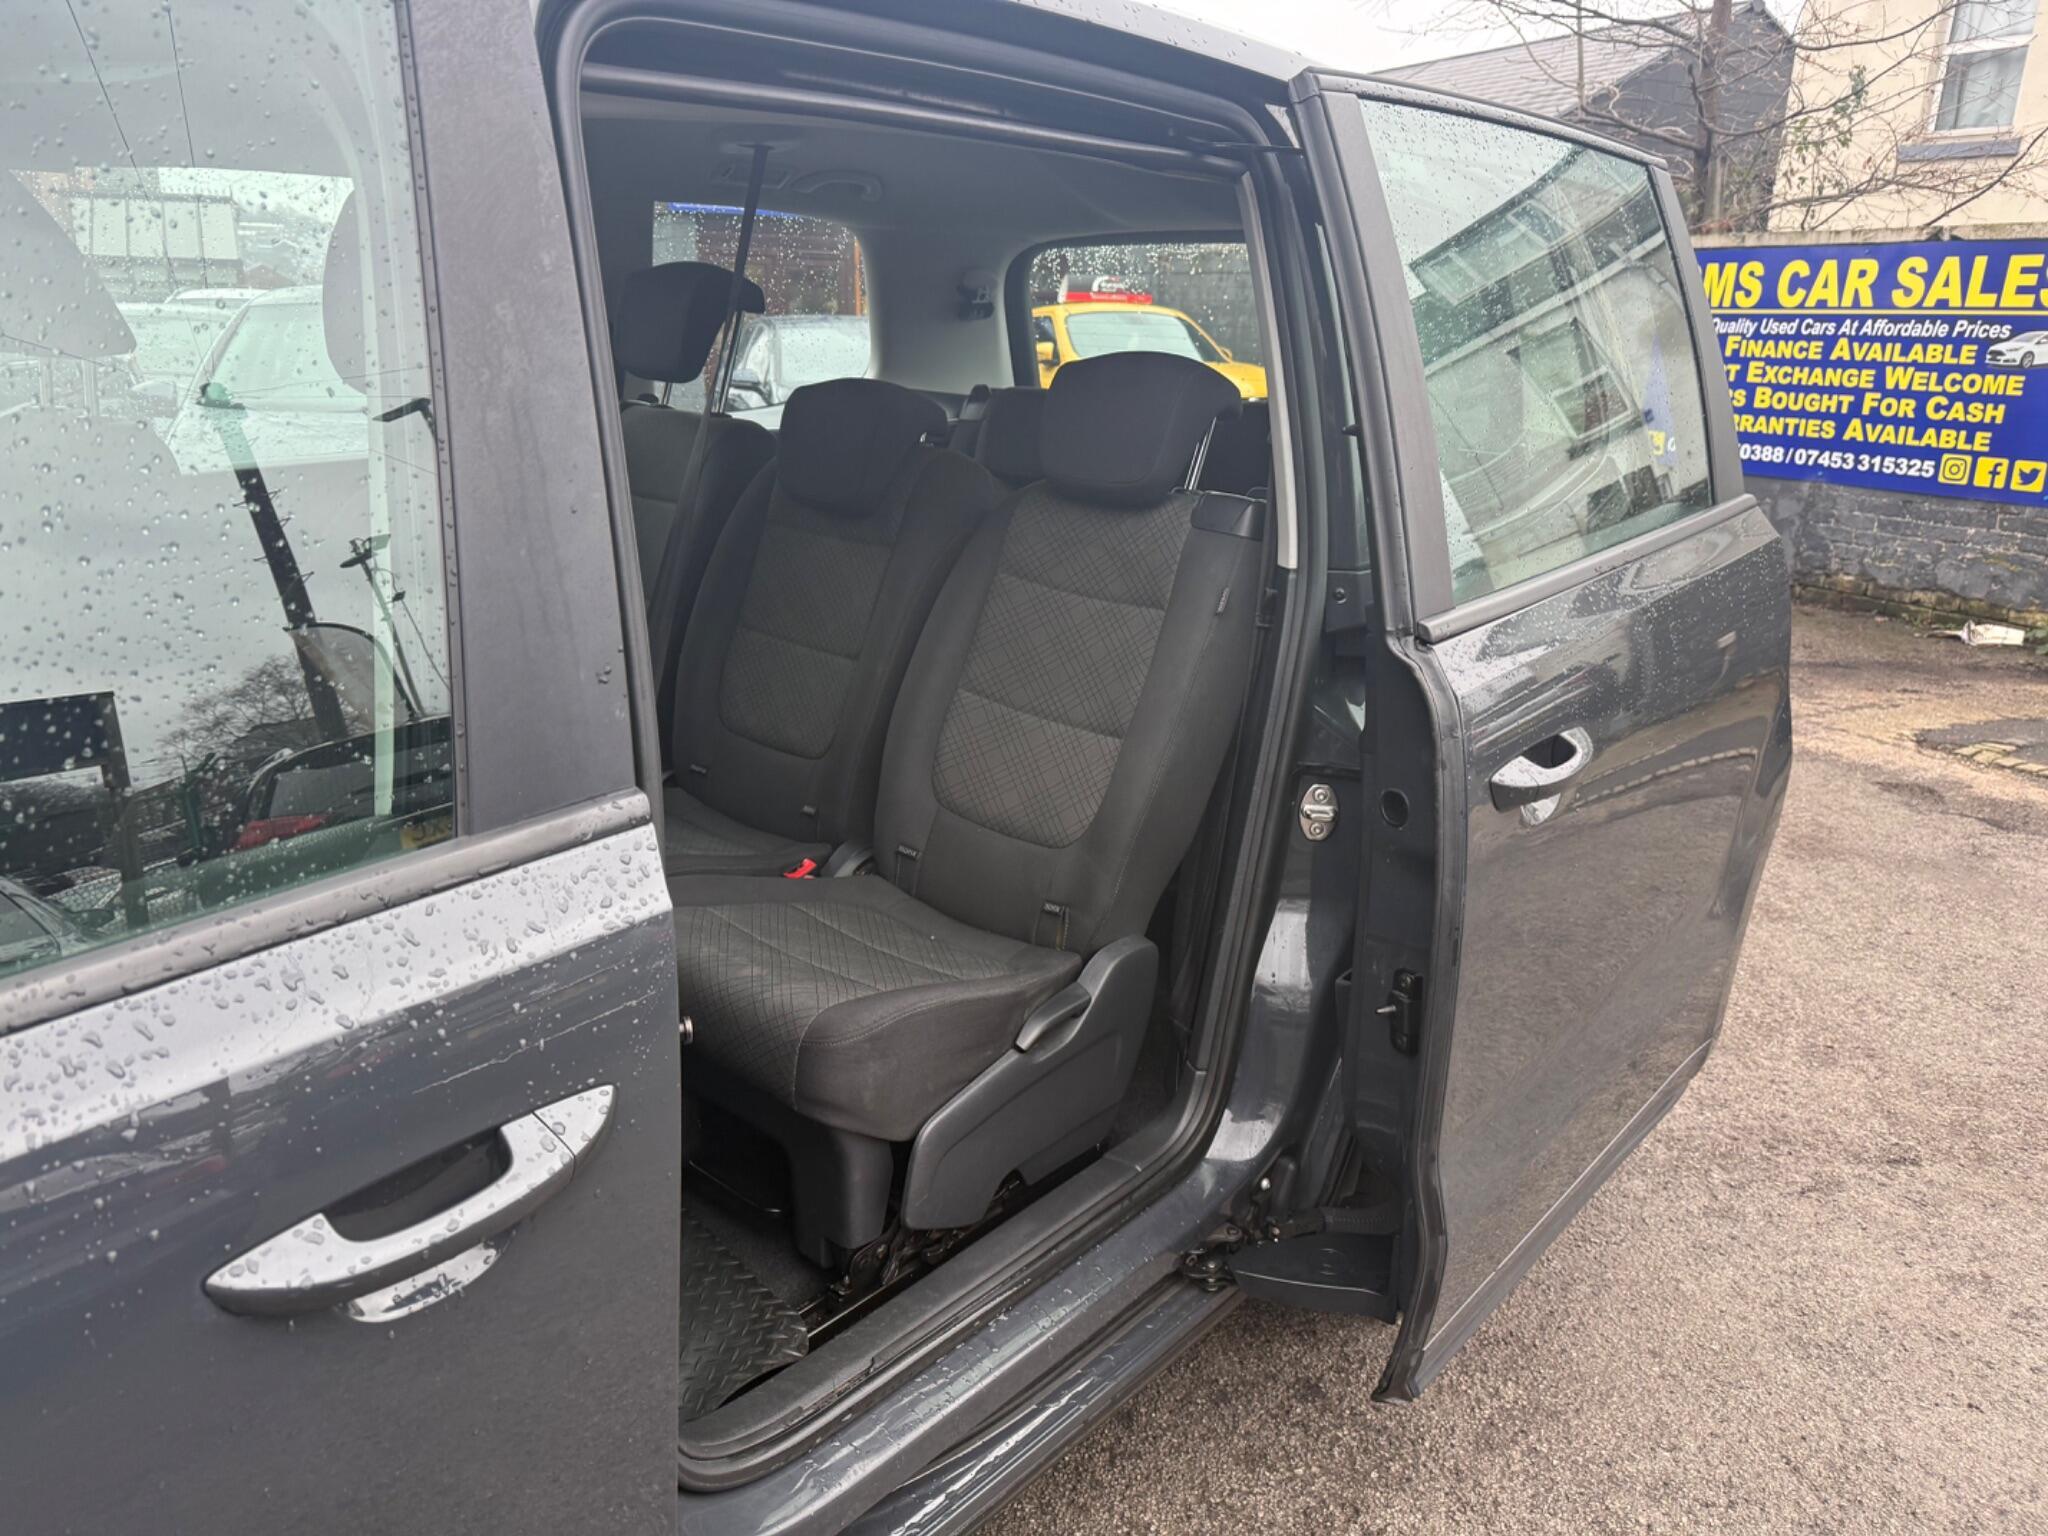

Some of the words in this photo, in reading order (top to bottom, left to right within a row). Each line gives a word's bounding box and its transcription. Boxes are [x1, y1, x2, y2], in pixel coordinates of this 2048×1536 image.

[1776, 257, 1879, 308] CAR
[1891, 253, 2048, 308] SALE
[1760, 318, 1800, 335] Used
[1801, 318, 1836, 336] Cars
[1837, 319, 1860, 336] At
[1859, 319, 1949, 338] Affordable
[1952, 320, 2012, 339] Prices
[1724, 335, 1824, 359] FINANCE
[1830, 337, 1978, 365] AVAILABLE
[1746, 361, 1876, 388] EXCHANGE
[1885, 365, 2026, 396] WELCOME
[1754, 386, 1855, 414] BOUGHT
[1861, 391, 1916, 418] FOR
[1926, 395, 2006, 424] CASH
[1842, 418, 1992, 452] AVAILABLE
[1857, 454, 1935, 478] 315325
